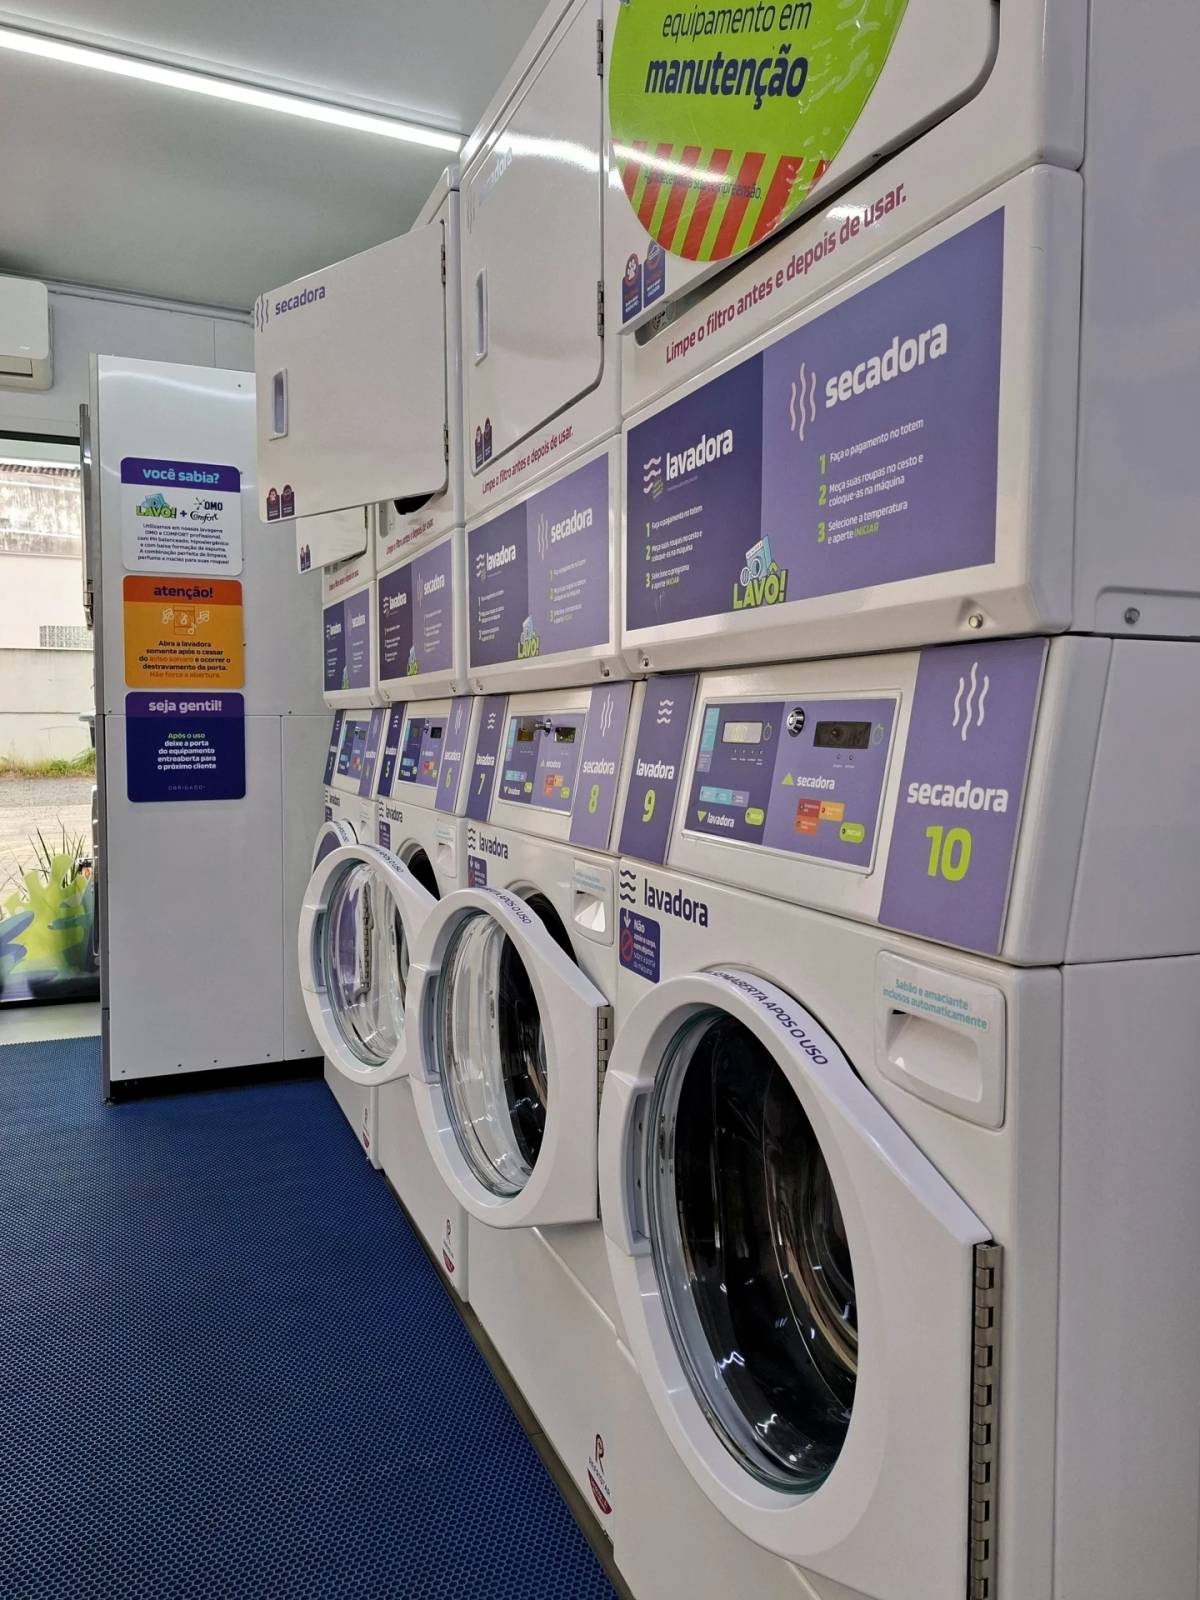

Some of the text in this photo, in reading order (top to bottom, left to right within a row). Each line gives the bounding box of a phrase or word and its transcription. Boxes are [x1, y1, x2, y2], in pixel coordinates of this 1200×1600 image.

[662, 1, 811, 47] equipamento em
[645, 44, 808, 110] manutenção
[667, 184, 907, 363] Limpe o filtro antes e depois de usar.
[275, 286, 326, 315] secadora
[825, 322, 948, 409] secadora
[666, 429, 733, 481] lavadora
[830, 451, 844, 464] Faça
[850, 431, 889, 456] pagamento
[890, 428, 900, 440] no
[901, 419, 924, 435] totem
[142, 468, 219, 485] você sabia?
[820, 454, 826, 474] 1
[846, 475, 860, 488] suas
[861, 466, 885, 484] roupas
[886, 463, 896, 474] no
[897, 455, 917, 471] cesto
[919, 454, 924, 463] e
[819, 484, 826, 506] 2
[829, 475, 905, 507] coloque-as na máquina
[190, 511, 219, 525] Comfort
[204, 501, 223, 512] OMO
[829, 515, 858, 532] Selecione
[864, 501, 908, 520] temperatura
[551, 507, 593, 544] secadora
[818, 521, 825, 543] 3
[833, 529, 853, 544] aperte
[487, 545, 516, 571] lavadora
[154, 586, 213, 600] atenção!
[733, 562, 788, 609] LAVÔ!
[178, 648, 196, 656] após
[182, 640, 211, 648] lavadora
[148, 699, 222, 714] seja gentil!
[168, 732, 186, 740] Após
[190, 740, 209, 748] porta
[169, 748, 215, 756] equipamento
[163, 763, 192, 771] próximo
[583, 758, 615, 776] secadora
[636, 759, 675, 780] lavadora
[478, 773, 485, 795] 7
[796, 775, 836, 790] secadora
[907, 779, 1009, 812] secadora
[588, 784, 600, 814] 8
[643, 789, 656, 824] 9
[707, 813, 735, 829] lavadora
[480, 832, 509, 860] lavadora
[925, 825, 972, 881] 10
[644, 878, 709, 928] lavadora
[895, 979, 917, 995] Sabão
[924, 987, 968, 1010] amaciante
[911, 996, 988, 1030] automaticamente
[790, 1029, 805, 1039] O
[800, 1040, 828, 1065] USO
